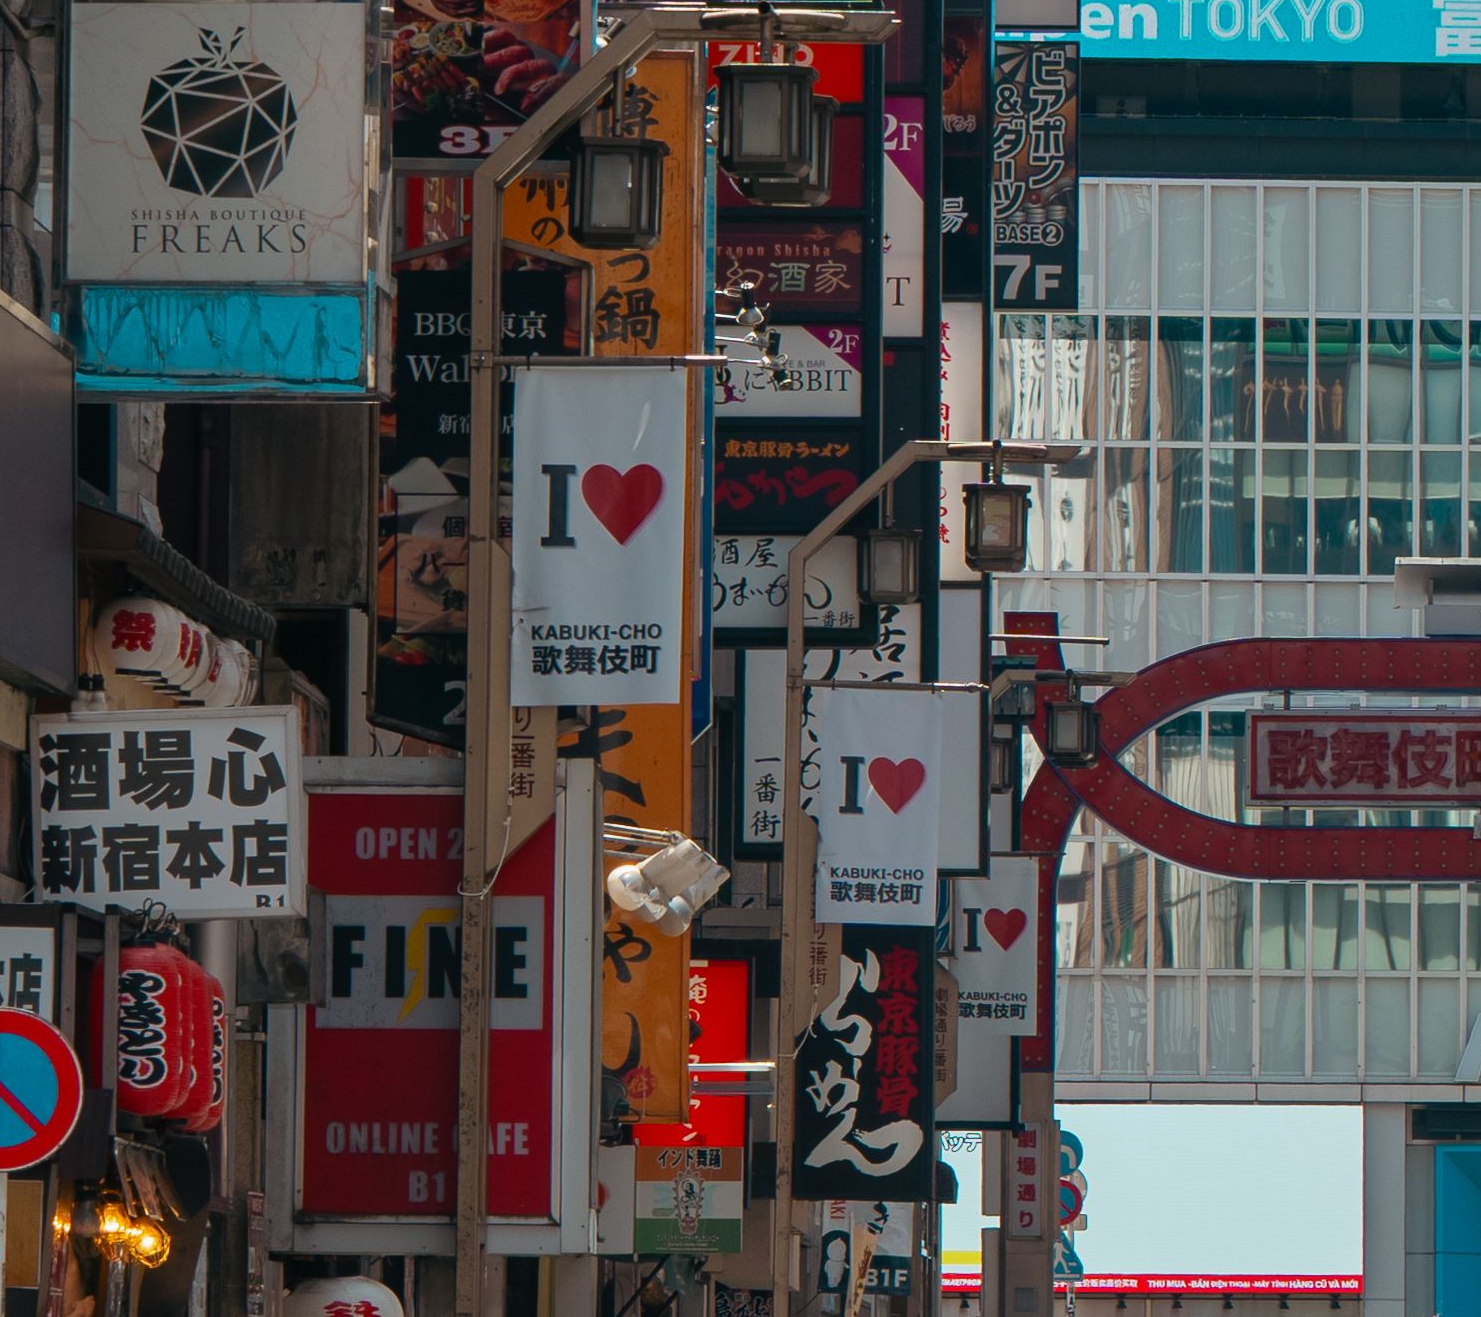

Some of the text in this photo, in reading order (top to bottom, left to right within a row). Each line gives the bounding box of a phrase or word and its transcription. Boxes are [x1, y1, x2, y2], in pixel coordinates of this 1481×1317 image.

[1029, 50, 1065, 189] ビアポン
[995, 87, 1023, 218] &ダーツ
[131, 209, 306, 221] SHISHA BOUTIQUE
[131, 224, 306, 253] FREAKS
[774, 243, 831, 257] Shisha
[995, 255, 1061, 300] 7F
[830, 329, 860, 353] 2F
[725, 441, 850, 458] 東京豚骨ラーメン
[541, 465, 576, 548] I
[113, 609, 155, 652] 祭
[531, 624, 662, 641] KABUKI-CHO
[531, 645, 661, 675] 歌舞伎町
[40, 728, 287, 812] 酒場心
[840, 757, 865, 814] I
[750, 756, 783, 840] 一番街
[41, 820, 289, 895] 新宿本店
[355, 828, 420, 860] OPEN
[830, 868, 924, 881] KABUKI-CHO
[830, 883, 923, 904] 歌舞伎町
[963, 908, 982, 953] I
[958, 992, 1027, 1002] KABUKI-CHO
[958, 1003, 1027, 1020] 歌舞伎町
[121, 971, 166, 1088] やきとり
[876, 946, 918, 1116] 東京豚骨
[325, 1122, 438, 1156] ONLINE
[408, 1170, 446, 1203] B1
[1016, 1130, 1037, 1229] 劇場通り
